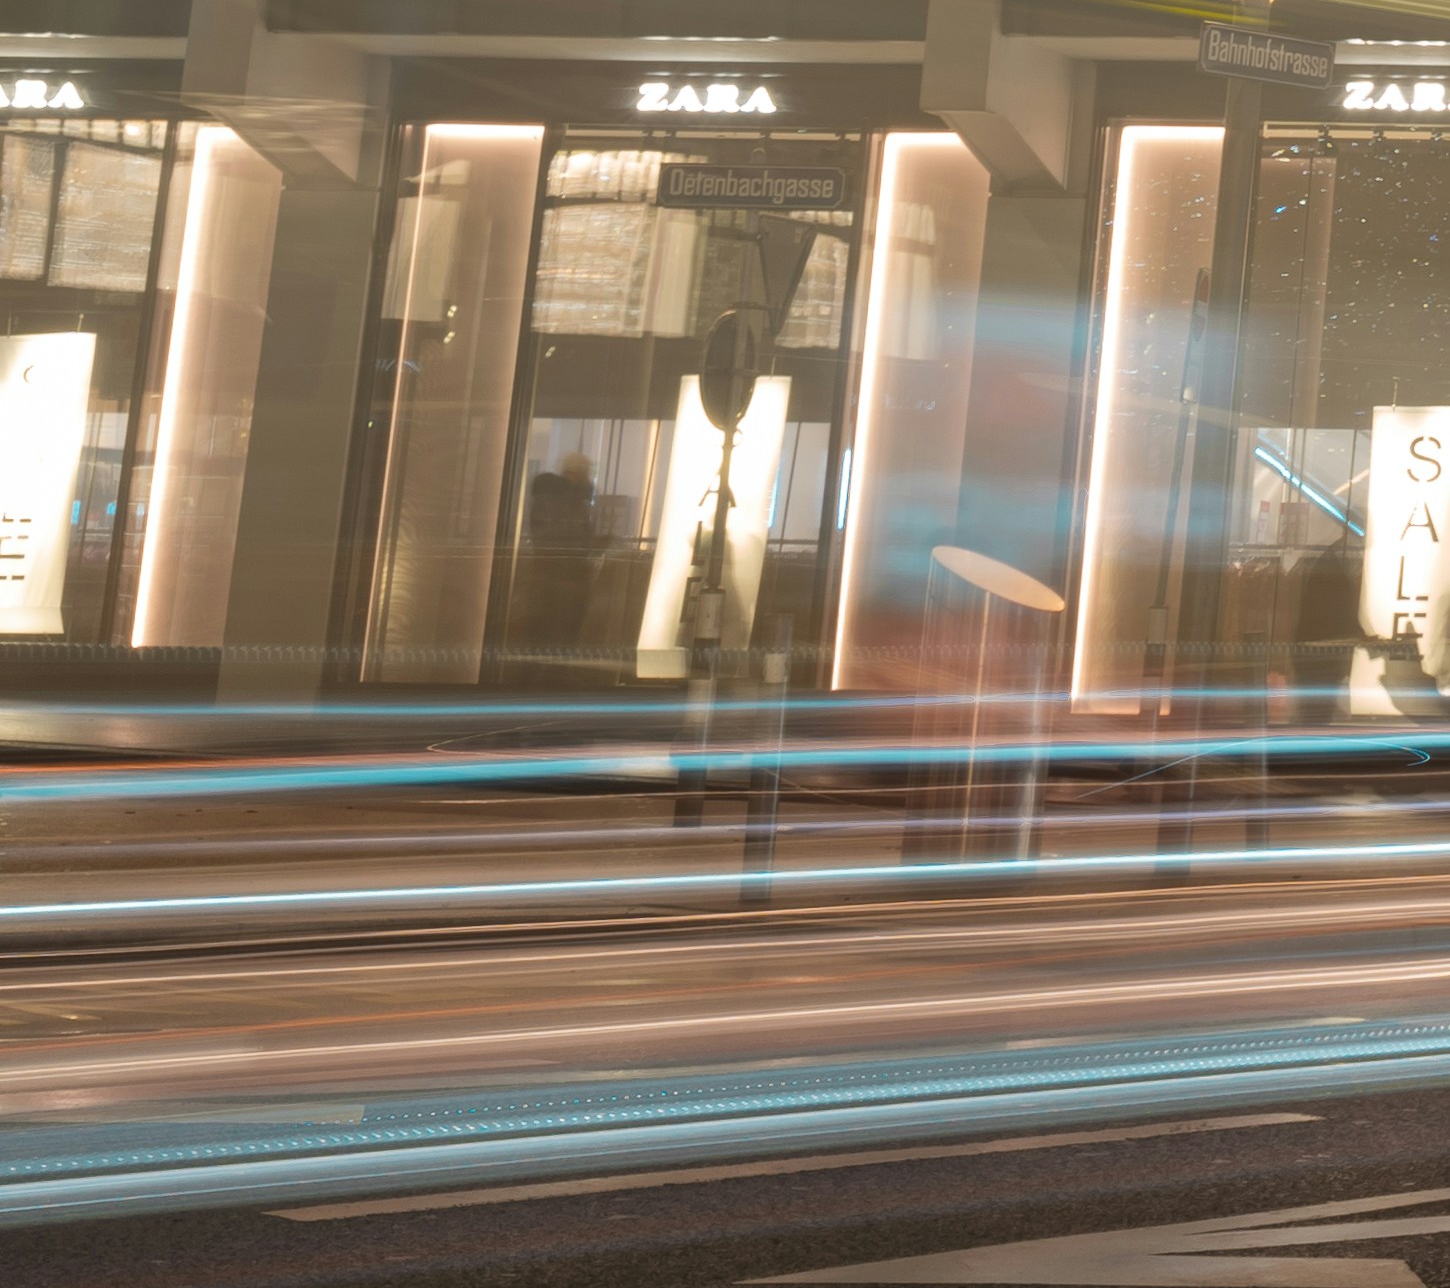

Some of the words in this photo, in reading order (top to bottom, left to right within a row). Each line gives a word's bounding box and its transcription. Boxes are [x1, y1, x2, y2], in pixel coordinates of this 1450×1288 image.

[1207, 29, 1328, 79] Bahnhofstrasse
[636, 82, 778, 114] ZARA
[669, 168, 835, 205] Oetenbachgasse
[1389, 435, 1442, 661] SALE
